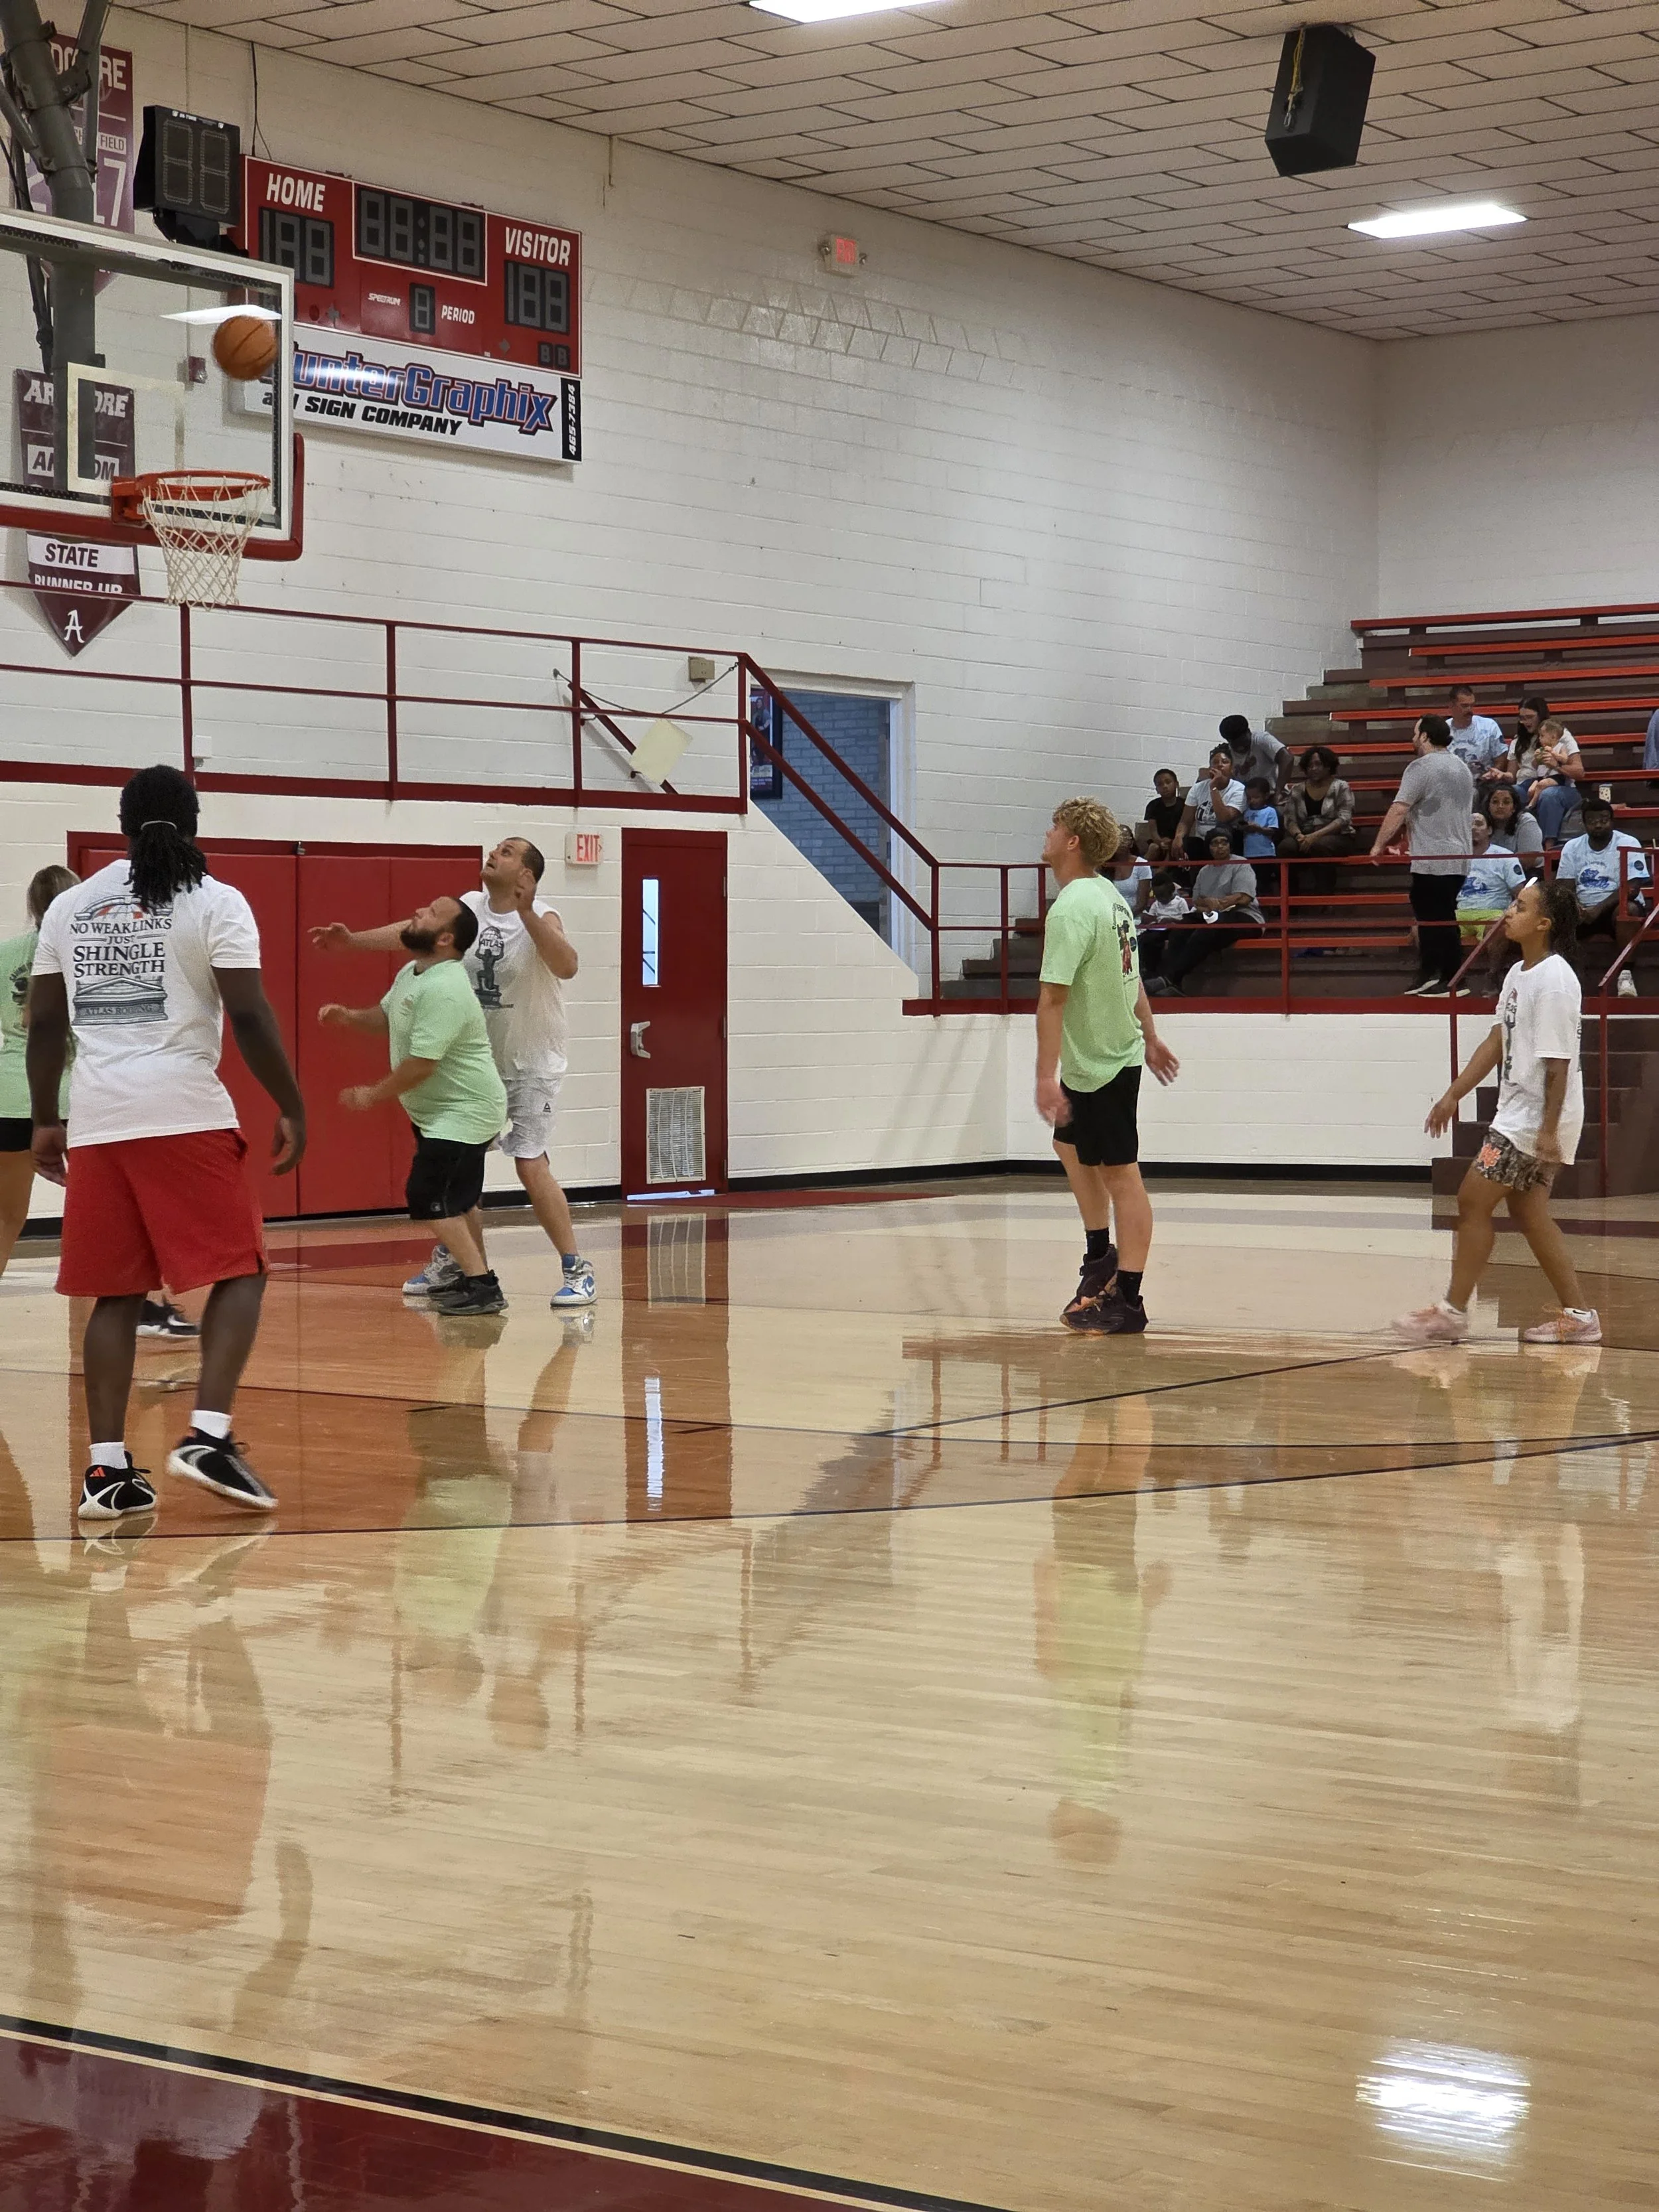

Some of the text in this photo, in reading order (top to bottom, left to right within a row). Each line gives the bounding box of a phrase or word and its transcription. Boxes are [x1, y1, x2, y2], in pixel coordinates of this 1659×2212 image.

[100, 135, 124, 151] FIELD
[266, 173, 326, 212] HOME
[505, 226, 571, 266] VISITOR
[368, 293, 401, 306] SPECTRUM
[441, 305, 475, 325] PERIOD
[294, 342, 557, 435] unterGraphix
[305, 396, 356, 419] SIGN
[361, 406, 463, 435] COMPANY
[567, 384, 576, 456] 465-7384
[44, 542, 99, 568] STATE
[64, 609, 85, 643] A
[577, 834, 600, 862] EXIT
[70, 918, 172, 934] NO WEAK LINKS
[108, 936, 134, 944] JUST
[479, 938, 504, 948] ATLAS
[73, 942, 165, 962] SHINGLE
[74, 960, 165, 978] STRENGTH
